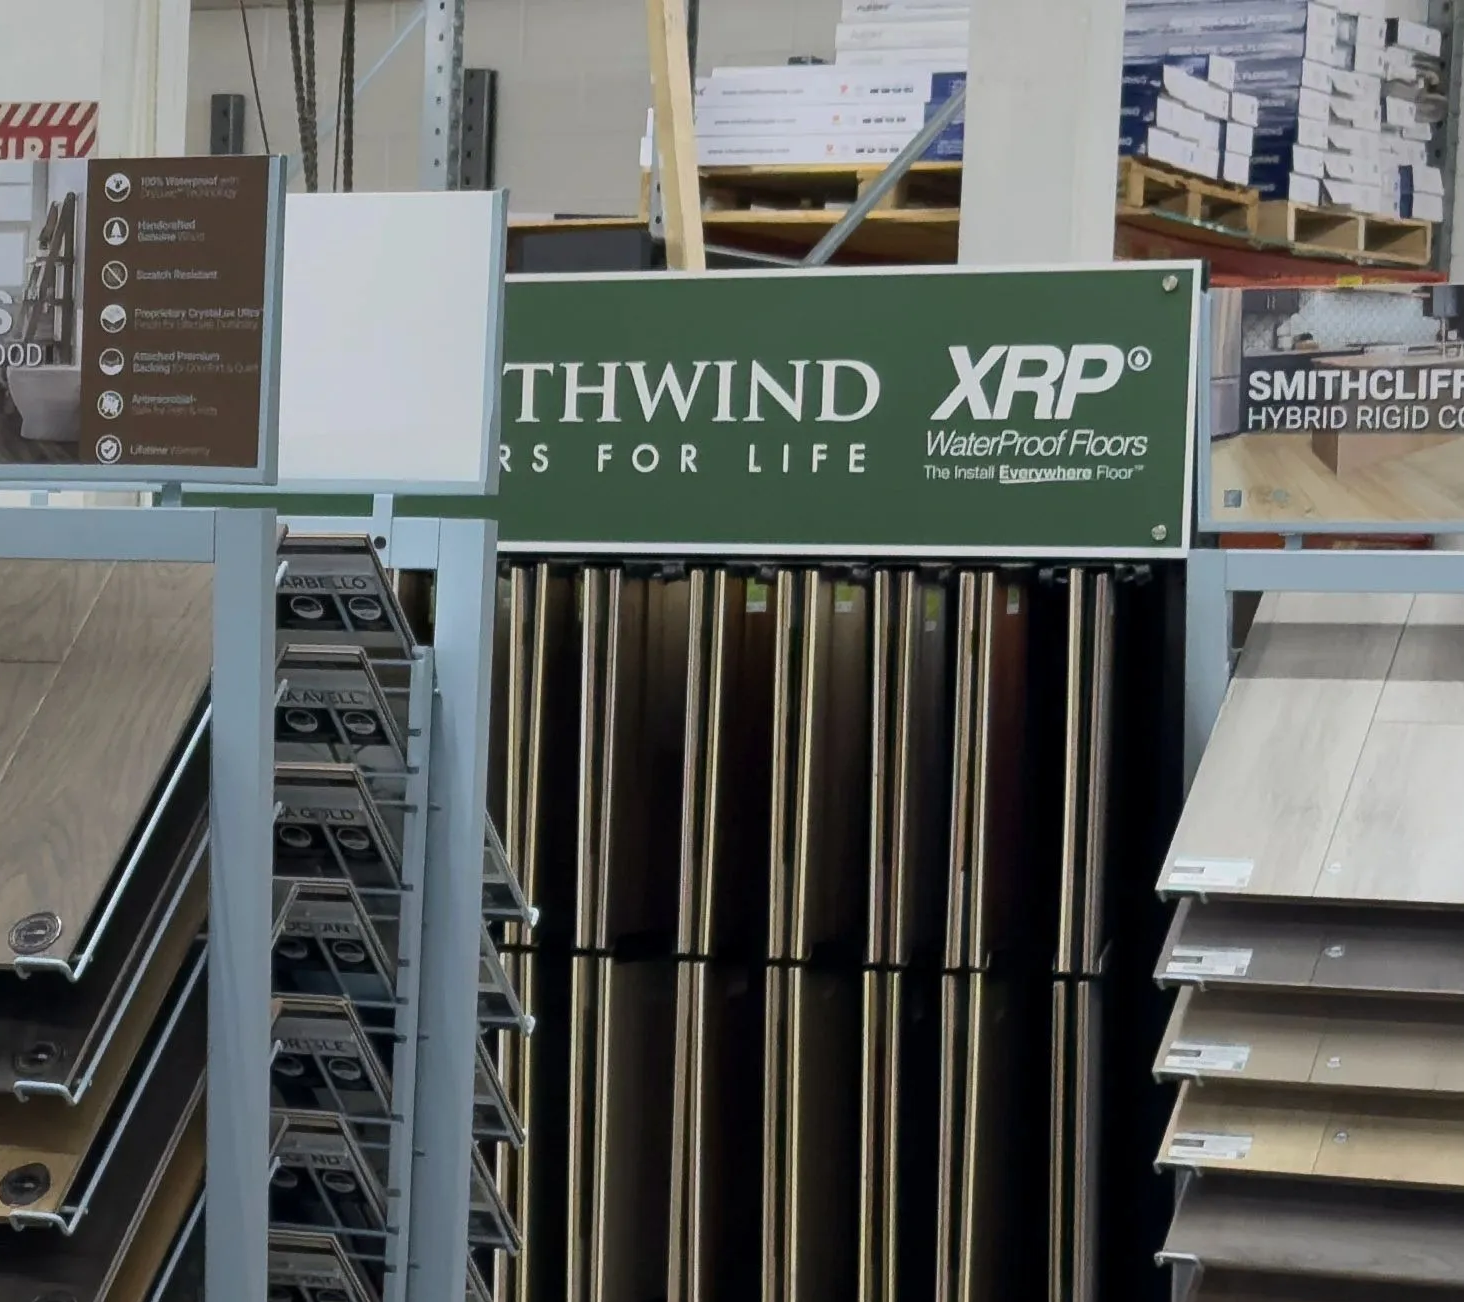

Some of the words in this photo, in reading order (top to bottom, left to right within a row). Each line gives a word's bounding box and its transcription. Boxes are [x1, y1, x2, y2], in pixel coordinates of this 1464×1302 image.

[1248, 406, 1347, 429] HYBRID
[1356, 405, 1429, 429] RIGID
[925, 430, 1066, 458] WaterProof
[1068, 430, 1148, 458] Floors
[598, 443, 698, 474] FOR
[749, 443, 865, 473] LIFE
[924, 464, 950, 480] The
[954, 464, 995, 480] Install
[999, 464, 1092, 484] Everywhere
